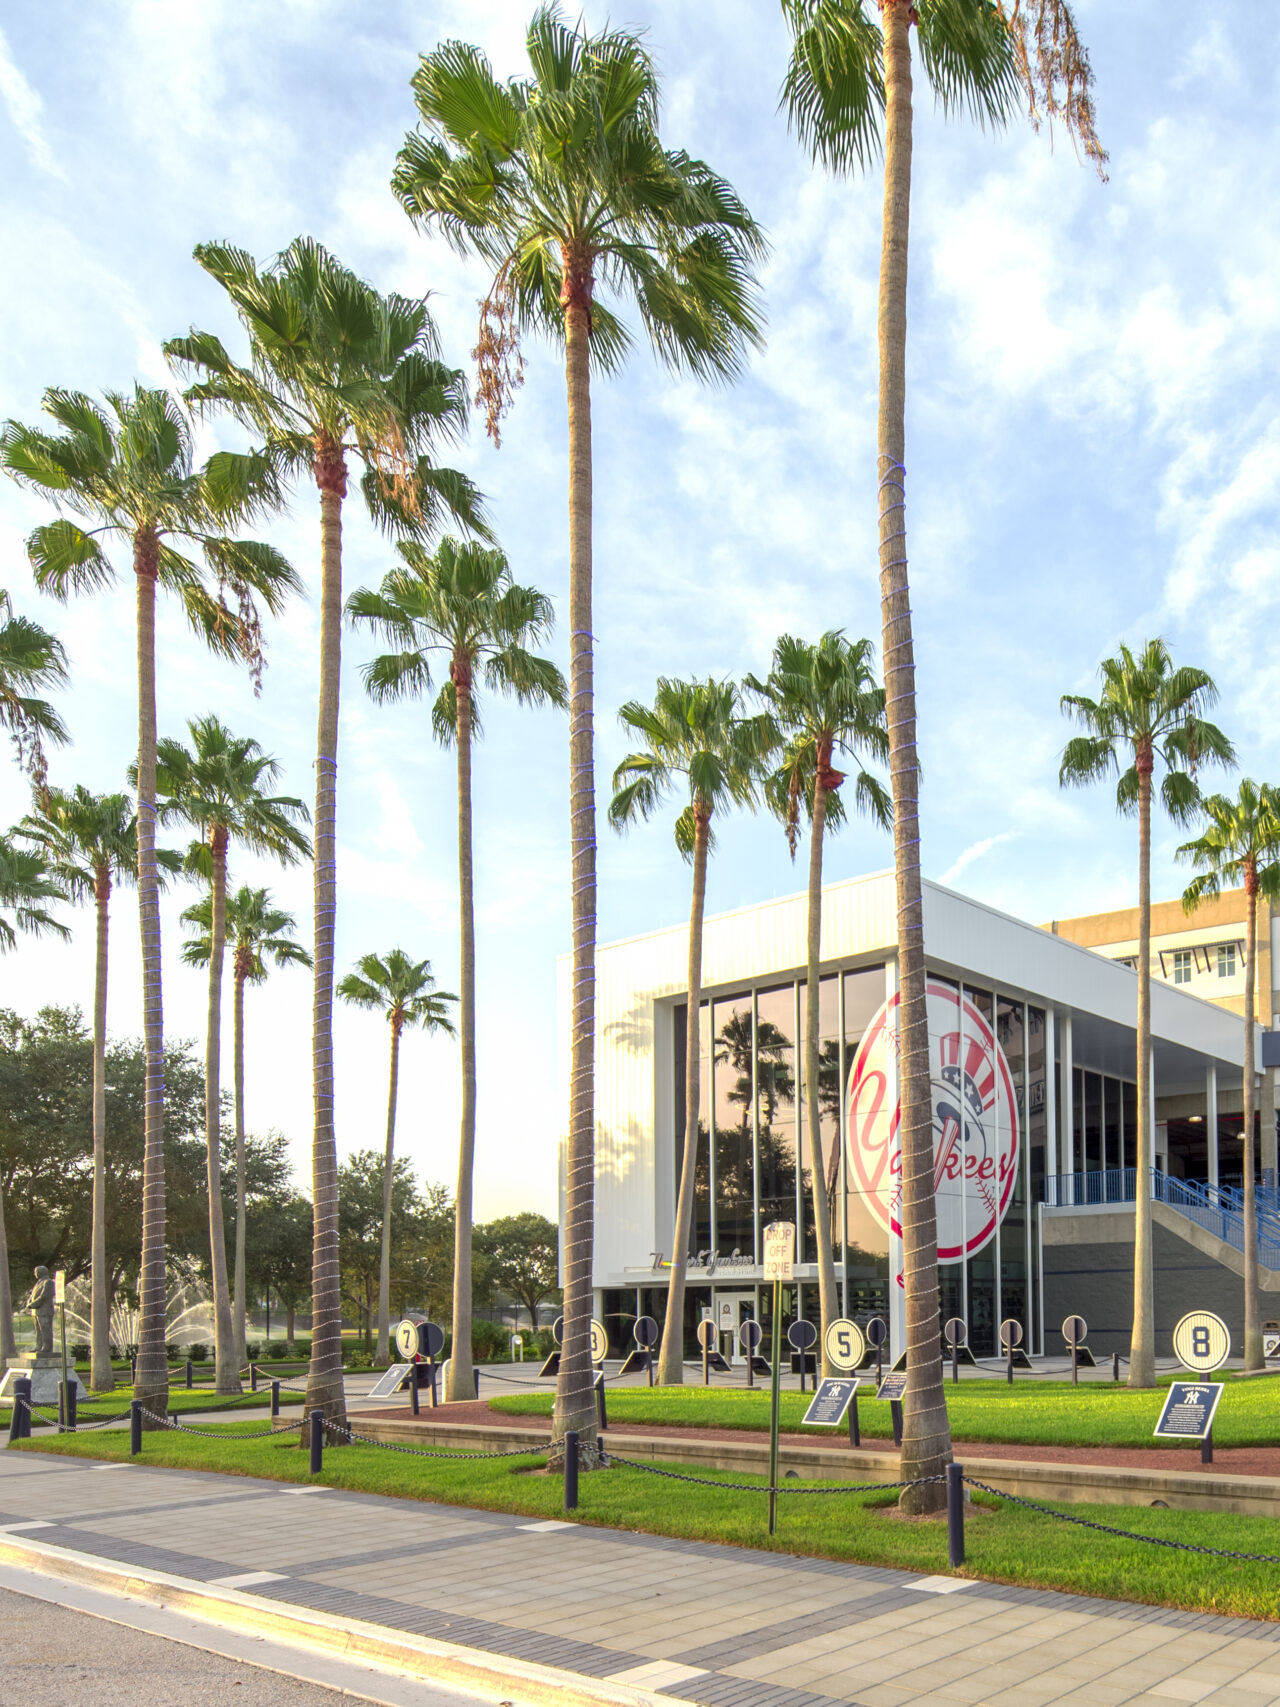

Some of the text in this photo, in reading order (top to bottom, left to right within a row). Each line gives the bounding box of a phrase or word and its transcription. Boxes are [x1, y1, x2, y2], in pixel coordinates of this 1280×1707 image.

[766, 1229, 792, 1240] DROP
[769, 1246, 787, 1256] OFF
[766, 1262, 790, 1273] ZONE
[403, 1330, 411, 1349] 7
[837, 1332, 851, 1357] 5
[1193, 1326, 1210, 1357] 8
